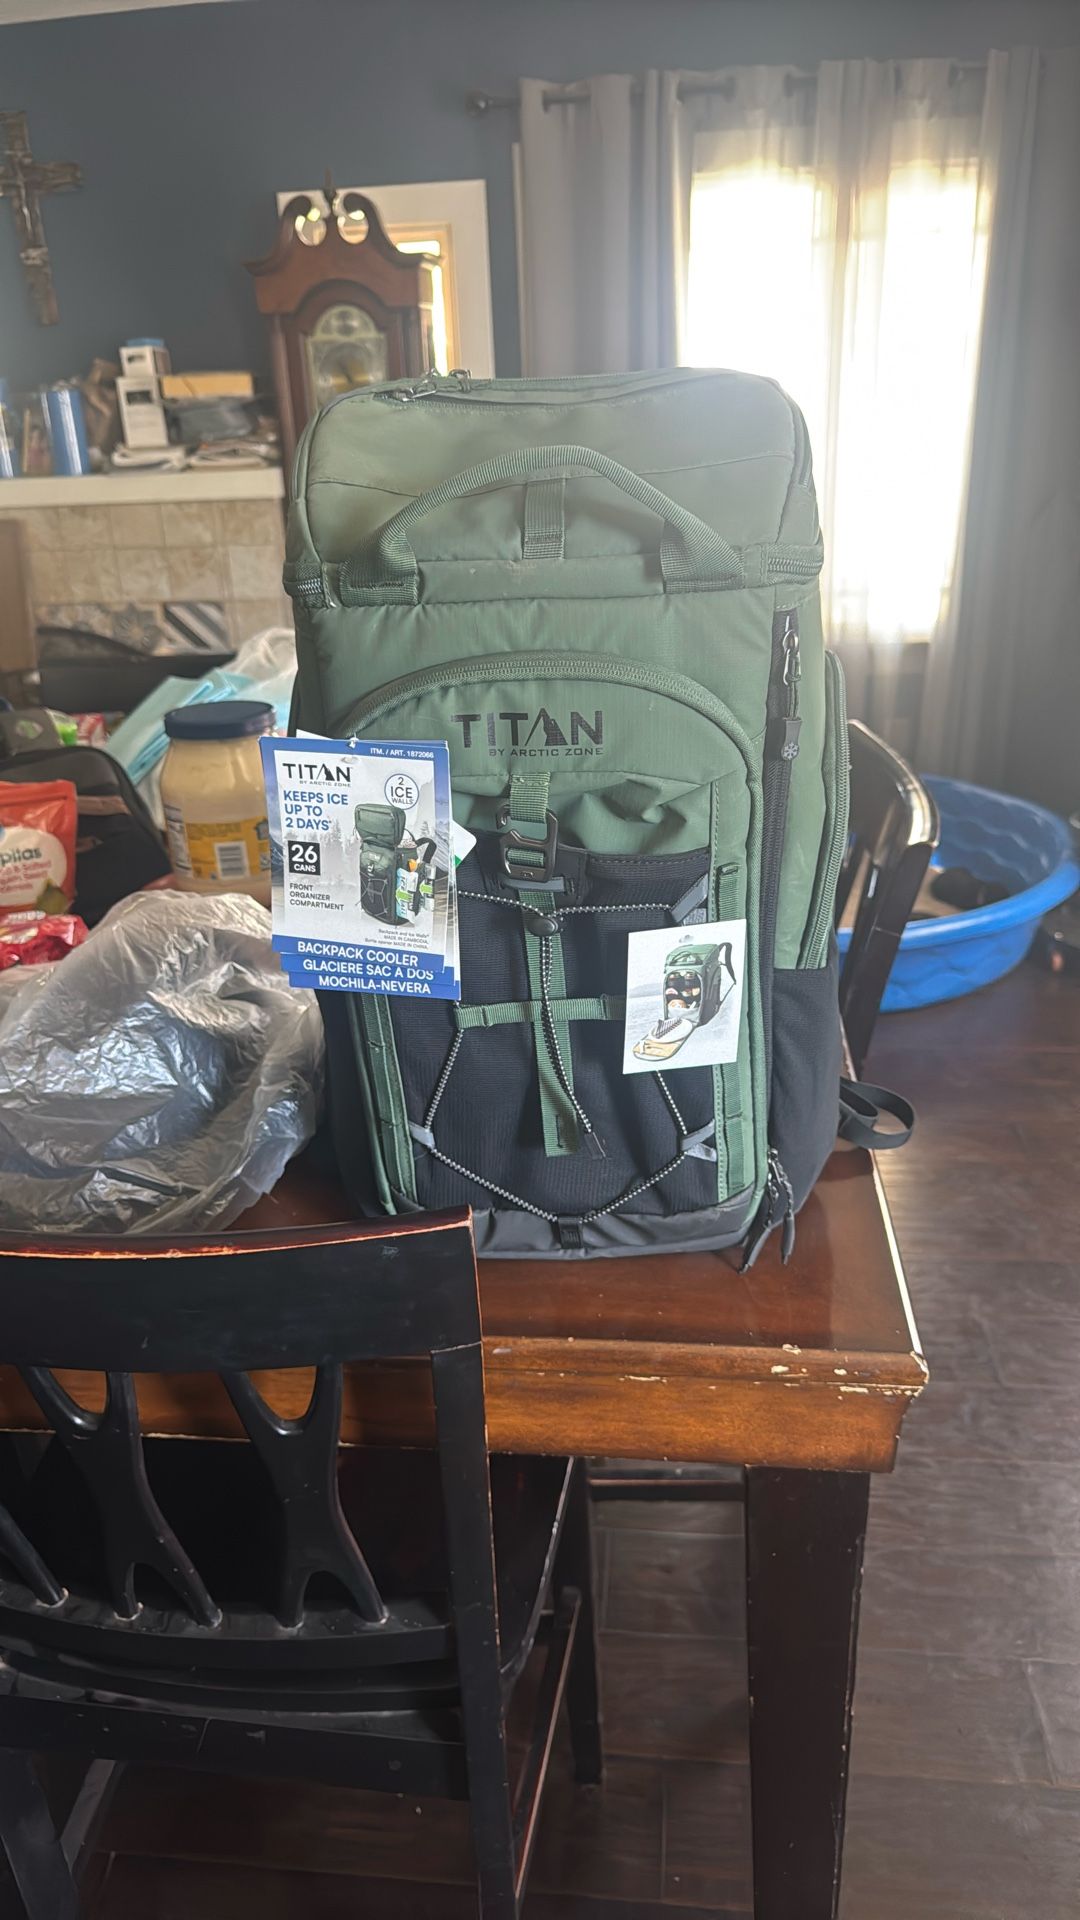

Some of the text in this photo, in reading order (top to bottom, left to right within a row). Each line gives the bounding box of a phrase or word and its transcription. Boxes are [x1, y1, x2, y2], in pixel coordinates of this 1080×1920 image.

[451, 707, 604, 748] TITAN
[370, 747, 384, 755] ITM.
[390, 749, 406, 757] ART.
[489, 747, 604, 757] BY ARCTIC ZONE
[282, 763, 351, 782] TITAN
[397, 776, 405, 786] 2
[283, 790, 349, 805] KEEPS ICE
[390, 785, 413, 799] ICE
[284, 803, 323, 817] UP TO
[285, 817, 294, 828] 2
[291, 843, 318, 864] 26
[293, 863, 317, 873] CANS
[289, 882, 314, 892] FRONT
[289, 890, 331, 901] ORGANIZER
[289, 898, 345, 911] COMPARTMENT
[297, 941, 418, 967] BACKPACK COOLER
[365, 963, 392, 977] SAC
[406, 967, 434, 981] DOS
[318, 975, 432, 995] MOCHILA-NEVERA
